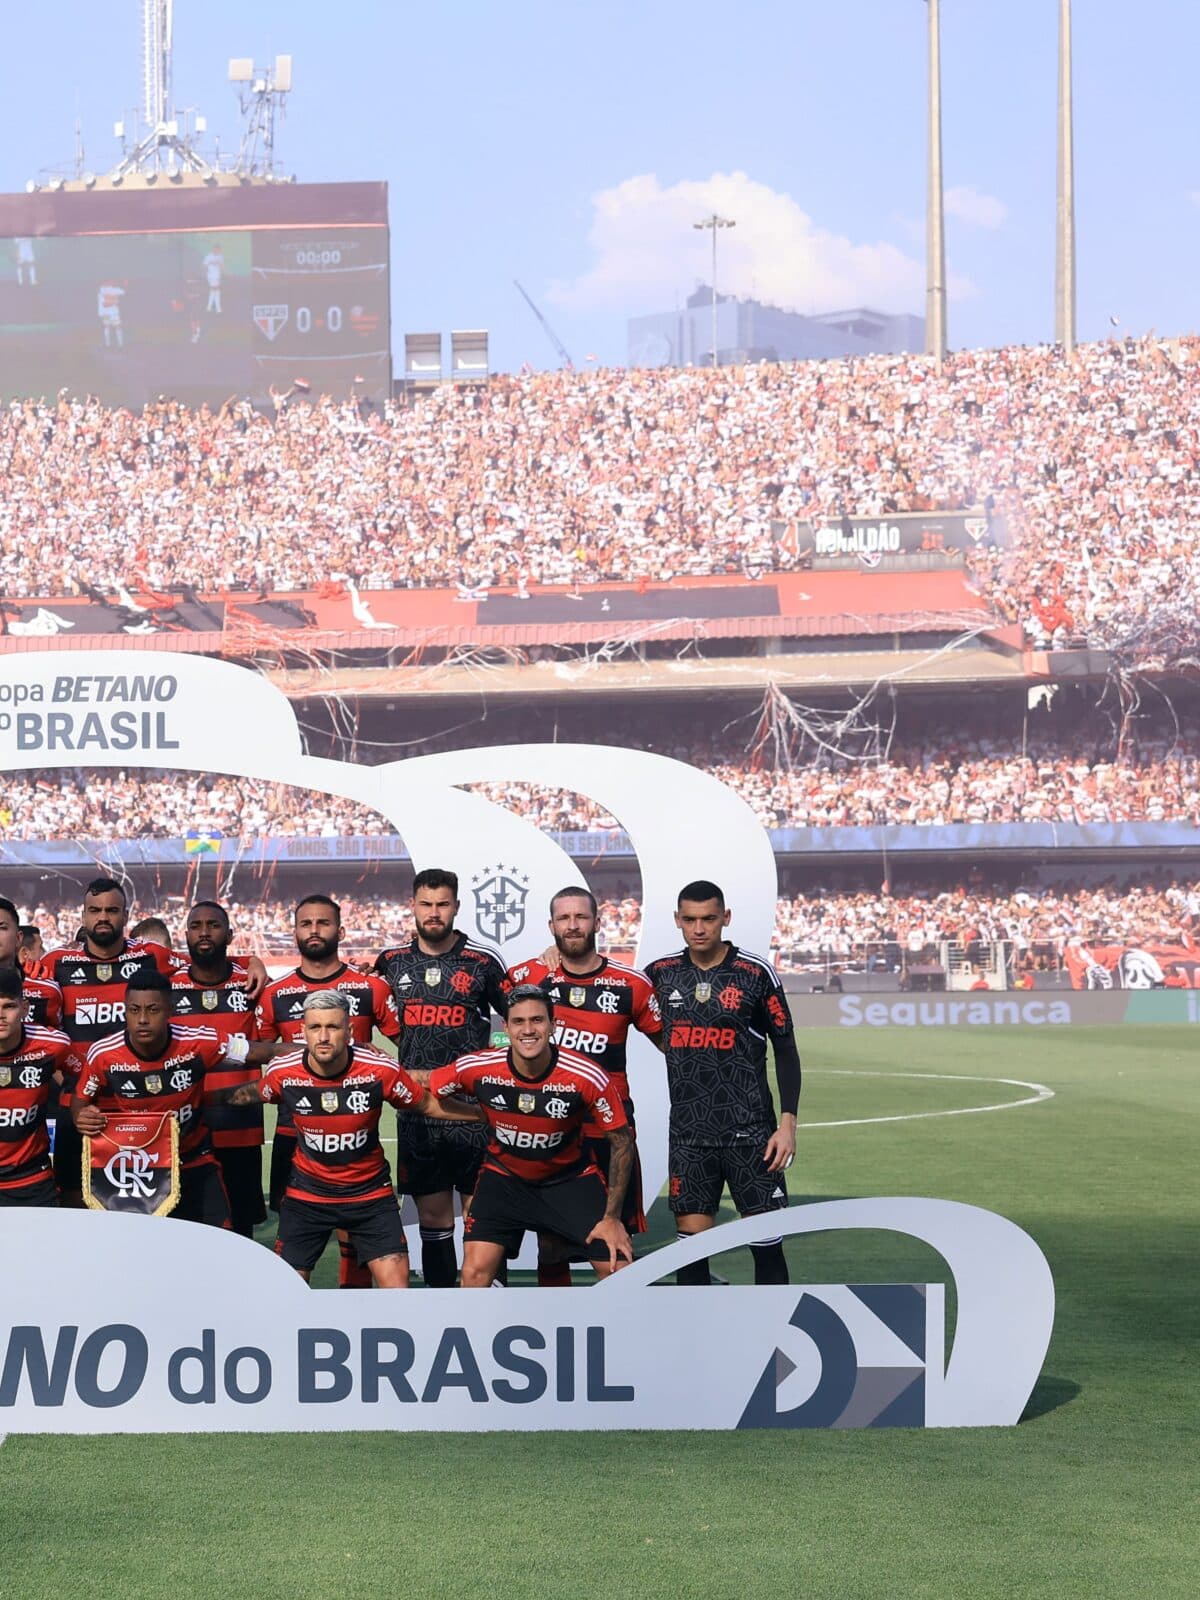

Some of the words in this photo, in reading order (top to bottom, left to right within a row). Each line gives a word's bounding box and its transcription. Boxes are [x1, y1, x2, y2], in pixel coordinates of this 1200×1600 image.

[297, 307, 311, 332] 0
[327, 306, 341, 332] 0
[51, 675, 177, 702] BETANO
[16, 711, 179, 750] BRASIL
[490, 904, 511, 913] CBF
[337, 981, 369, 992] pixbet
[594, 976, 626, 986] pixbet
[276, 984, 307, 998] pixbet
[97, 1002, 126, 1024] BR
[421, 1005, 466, 1027] BRB
[562, 1027, 608, 1054] BRB
[690, 1027, 736, 1049] BRB
[110, 1062, 141, 1073] pixbet
[164, 1052, 195, 1070] pixbet
[282, 1077, 314, 1088] pixbet
[343, 1074, 376, 1088] pixbet
[482, 1075, 516, 1087] pixbet
[542, 1082, 576, 1093] pixbet
[324, 1129, 369, 1153] BRB
[516, 1131, 564, 1149] BRB
[167, 1329, 272, 1403] do
[298, 1326, 635, 1403] BRASIL
